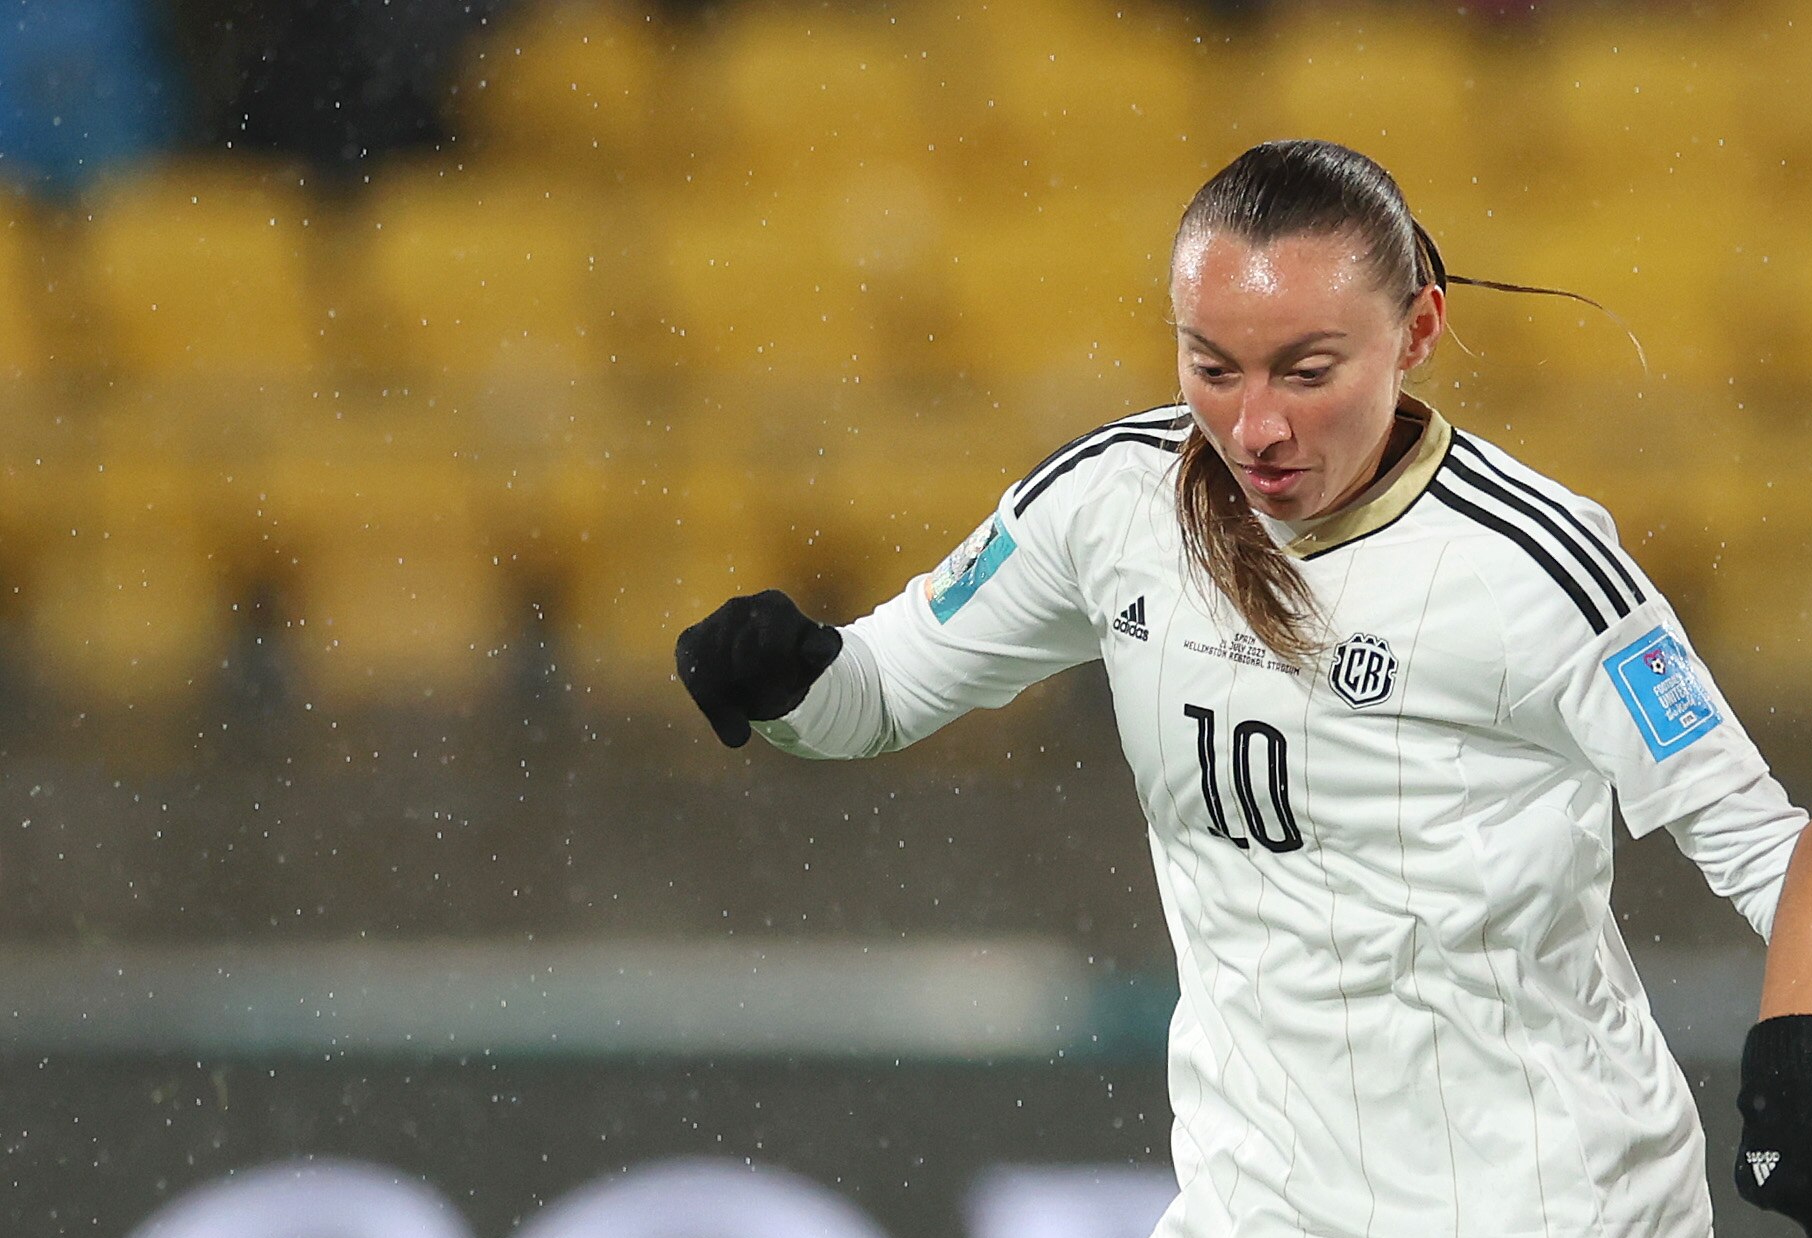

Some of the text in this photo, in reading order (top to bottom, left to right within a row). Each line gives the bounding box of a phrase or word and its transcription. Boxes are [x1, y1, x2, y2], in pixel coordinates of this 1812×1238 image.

[1112, 617, 1149, 642] adidas
[1234, 632, 1256, 645] SPAIN
[1227, 649, 1265, 669] REGIONAL
[1228, 640, 1246, 653] JULY
[1246, 643, 1266, 658] 2023
[1184, 703, 1304, 853] 10
